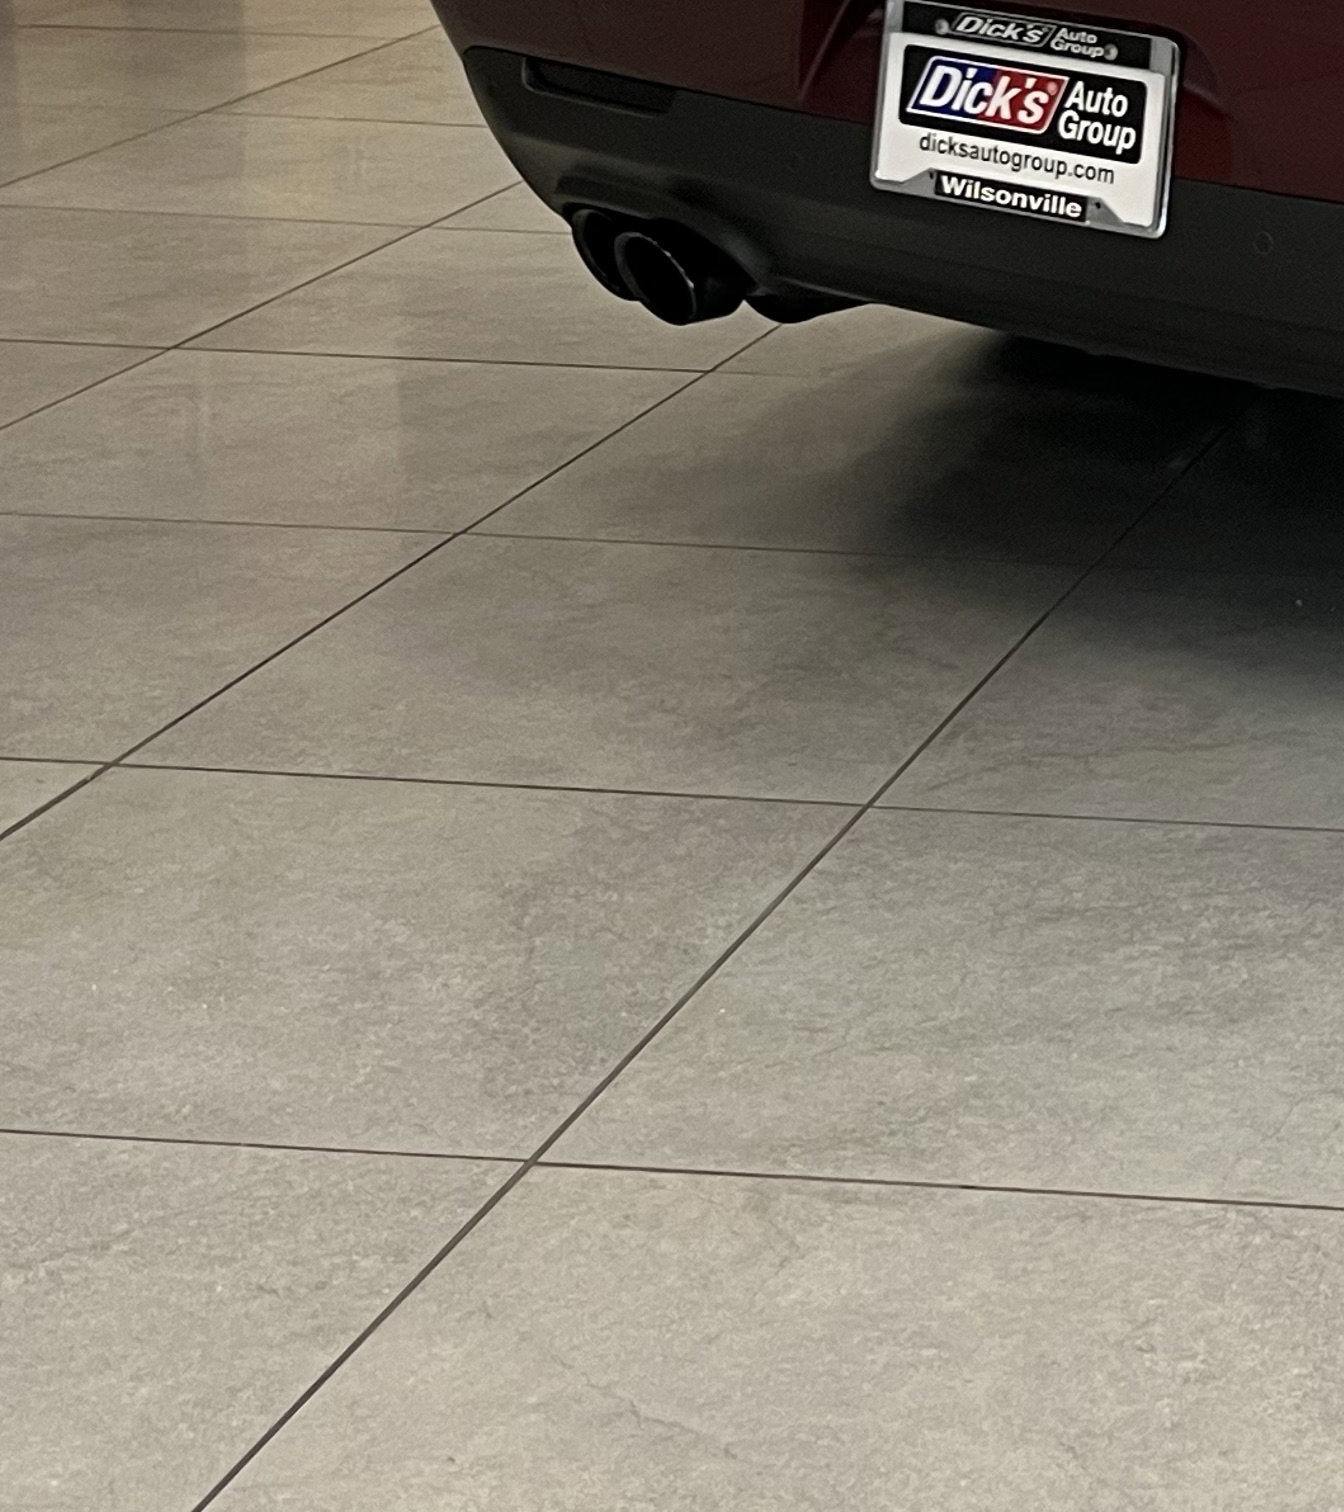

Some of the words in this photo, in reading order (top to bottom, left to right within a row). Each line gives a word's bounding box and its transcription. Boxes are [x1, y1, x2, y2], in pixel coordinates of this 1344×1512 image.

[956, 16, 1044, 43] Dick's
[1056, 27, 1098, 44] Auto
[1050, 38, 1104, 58] Group
[919, 64, 1050, 125] Dick's
[1063, 80, 1129, 117] Auto
[1057, 109, 1137, 154] Group
[919, 132, 1115, 184] dicksautogroup.com
[939, 175, 1083, 217] Wilsonville
